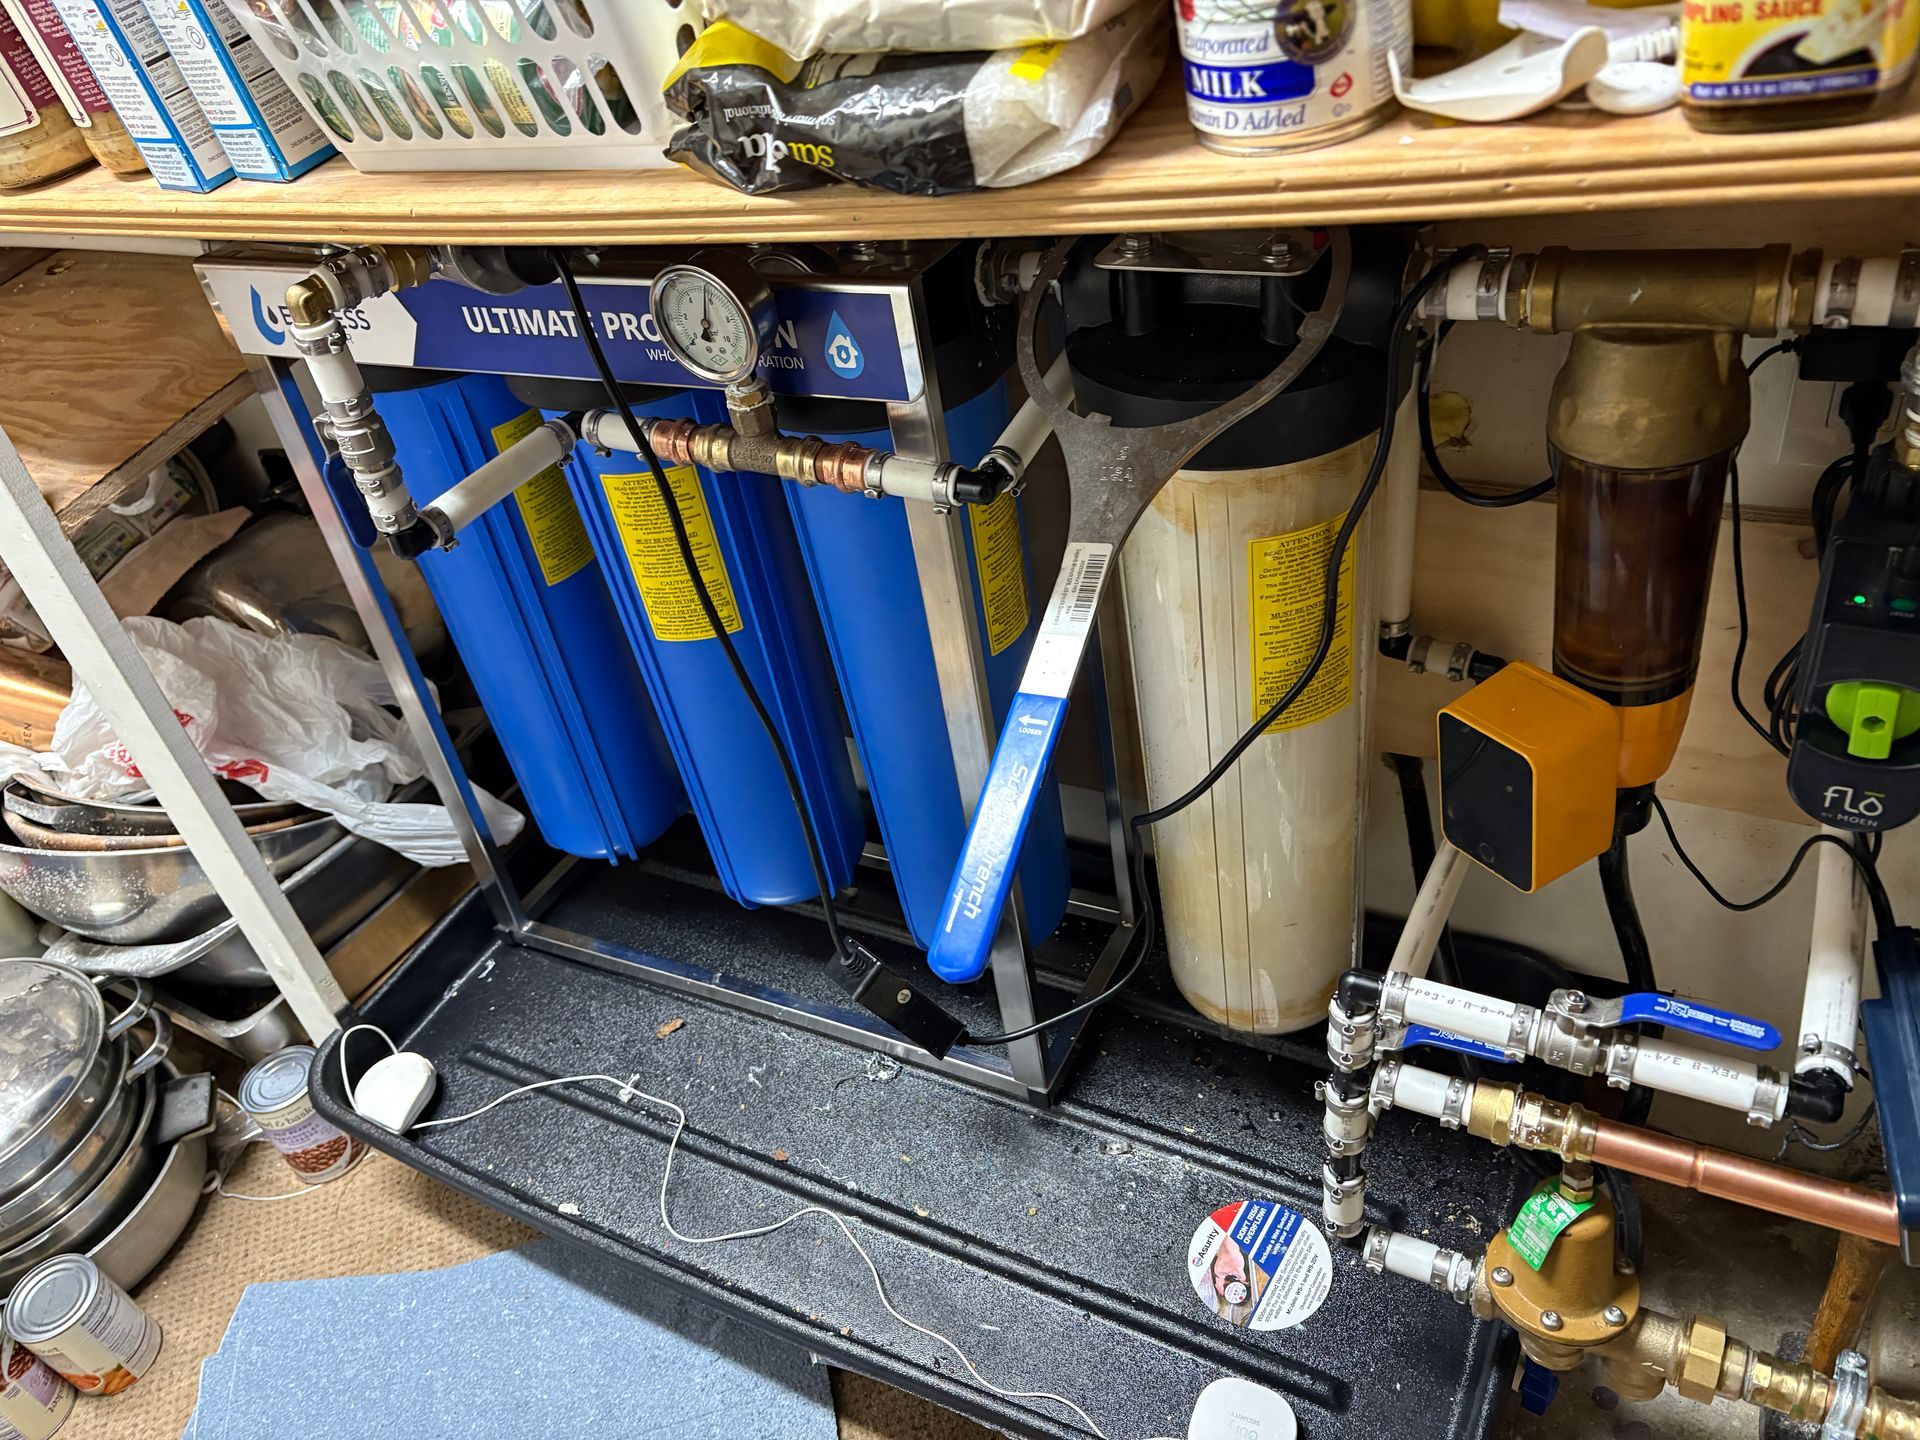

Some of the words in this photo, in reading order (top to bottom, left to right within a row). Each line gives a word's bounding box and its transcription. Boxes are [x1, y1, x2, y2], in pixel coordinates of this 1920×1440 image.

[1190, 66, 1267, 98] MILK
[1224, 110, 1239, 130] D
[1243, 104, 1306, 130] Added
[461, 306, 598, 339] ULTIMAT
[1285, 654, 1313, 666] CAUTI
[1837, 813, 1878, 828] MOEN
[1237, 1220, 1250, 1239] DON'T
[1247, 1204, 1259, 1220] RISK
[1243, 1207, 1266, 1244] OVERFLOW!
[1198, 1227, 1218, 1258] Asurity
